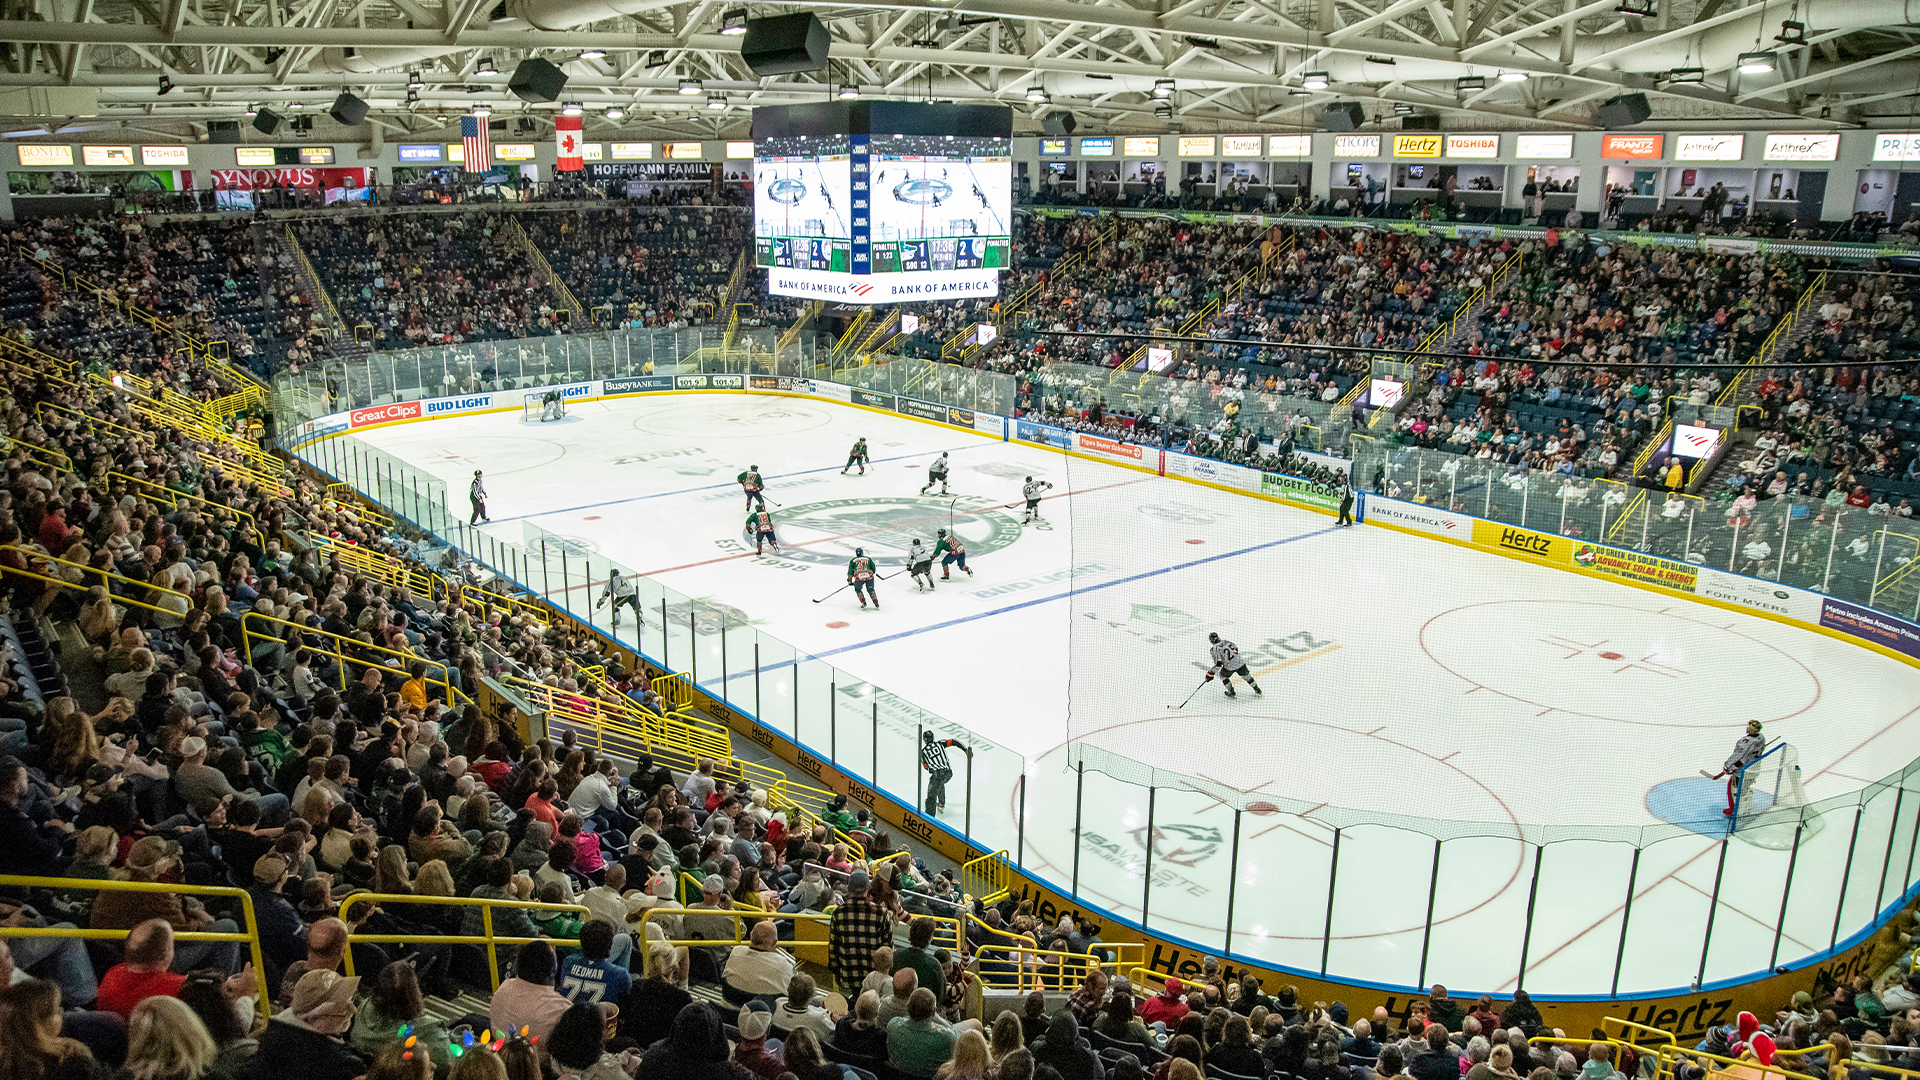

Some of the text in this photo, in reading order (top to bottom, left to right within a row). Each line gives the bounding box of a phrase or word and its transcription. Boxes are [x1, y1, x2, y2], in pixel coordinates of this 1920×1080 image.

[1232, 140, 1260, 151] TAMIAMI
[1335, 136, 1378, 147] encore
[1398, 138, 1437, 151] Hertz
[1450, 140, 1495, 148] TOSHIBA
[1610, 141, 1654, 149] FRANTZ
[1684, 142, 1720, 151] Arthrex
[1771, 142, 1813, 153] Arthrex
[22, 146, 70, 157] BONITA
[144, 149, 186, 157] TOSHIBA
[593, 163, 712, 175] HOFFMANN FAMILY
[812, 241, 818, 256] 2
[919, 242, 924, 257] 1
[932, 240, 955, 253] 17:36
[960, 241, 966, 256] 2
[933, 252, 952, 261] PERIOD
[957, 259, 977, 267] SOG 11
[906, 261, 927, 270] SOG 13
[779, 279, 847, 295] BANK OF AMERICA
[891, 281, 989, 295] BANK OF AMERICA
[832, 303, 865, 312] Aren
[563, 385, 590, 397] IGHT
[428, 396, 491, 412] BUD LIGHT
[353, 404, 416, 423] Great Clips
[913, 408, 936, 419] COMPANIES
[614, 447, 706, 465] Hertz
[1026, 484, 1036, 494] 29
[1263, 474, 1303, 490] BUDGET
[775, 498, 897, 517] FLORIDA
[758, 514, 769, 524] 18
[1371, 506, 1392, 516] BANK
[1404, 514, 1438, 526] AMERICA
[715, 538, 747, 555] EST.
[1501, 528, 1551, 552] Hertz
[750, 556, 810, 572] 1998
[855, 559, 869, 570] 37
[1596, 546, 1604, 555] GO
[1627, 553, 1637, 562] GO
[1660, 560, 1669, 569] GO
[1671, 563, 1698, 576] BLADES!
[1597, 556, 1695, 585] ADVANCE SOLAR & ENERGY
[971, 581, 1034, 599] BUD
[1706, 589, 1788, 613] FORT MYERS
[1824, 611, 1834, 619] All
[1858, 620, 1876, 633] Every
[1825, 604, 1846, 616] Metro
[1846, 610, 1874, 625] includes
[1874, 619, 1900, 634] Amazon
[1900, 628, 1920, 641] Prime.
[1223, 644, 1238, 661] 25
[710, 700, 730, 718] Hertz
[877, 693, 994, 752] Brown & Brown
[752, 724, 774, 746] Hertz
[927, 748, 939, 758] 10
[797, 750, 822, 774] Hertz
[848, 780, 876, 806] Hertz
[903, 812, 933, 840] Hertz
[1021, 884, 1102, 936] Hert
[570, 964, 605, 980] HEDMAN
[562, 975, 607, 1003] 77
[1619, 998, 1734, 1037] Hertz
